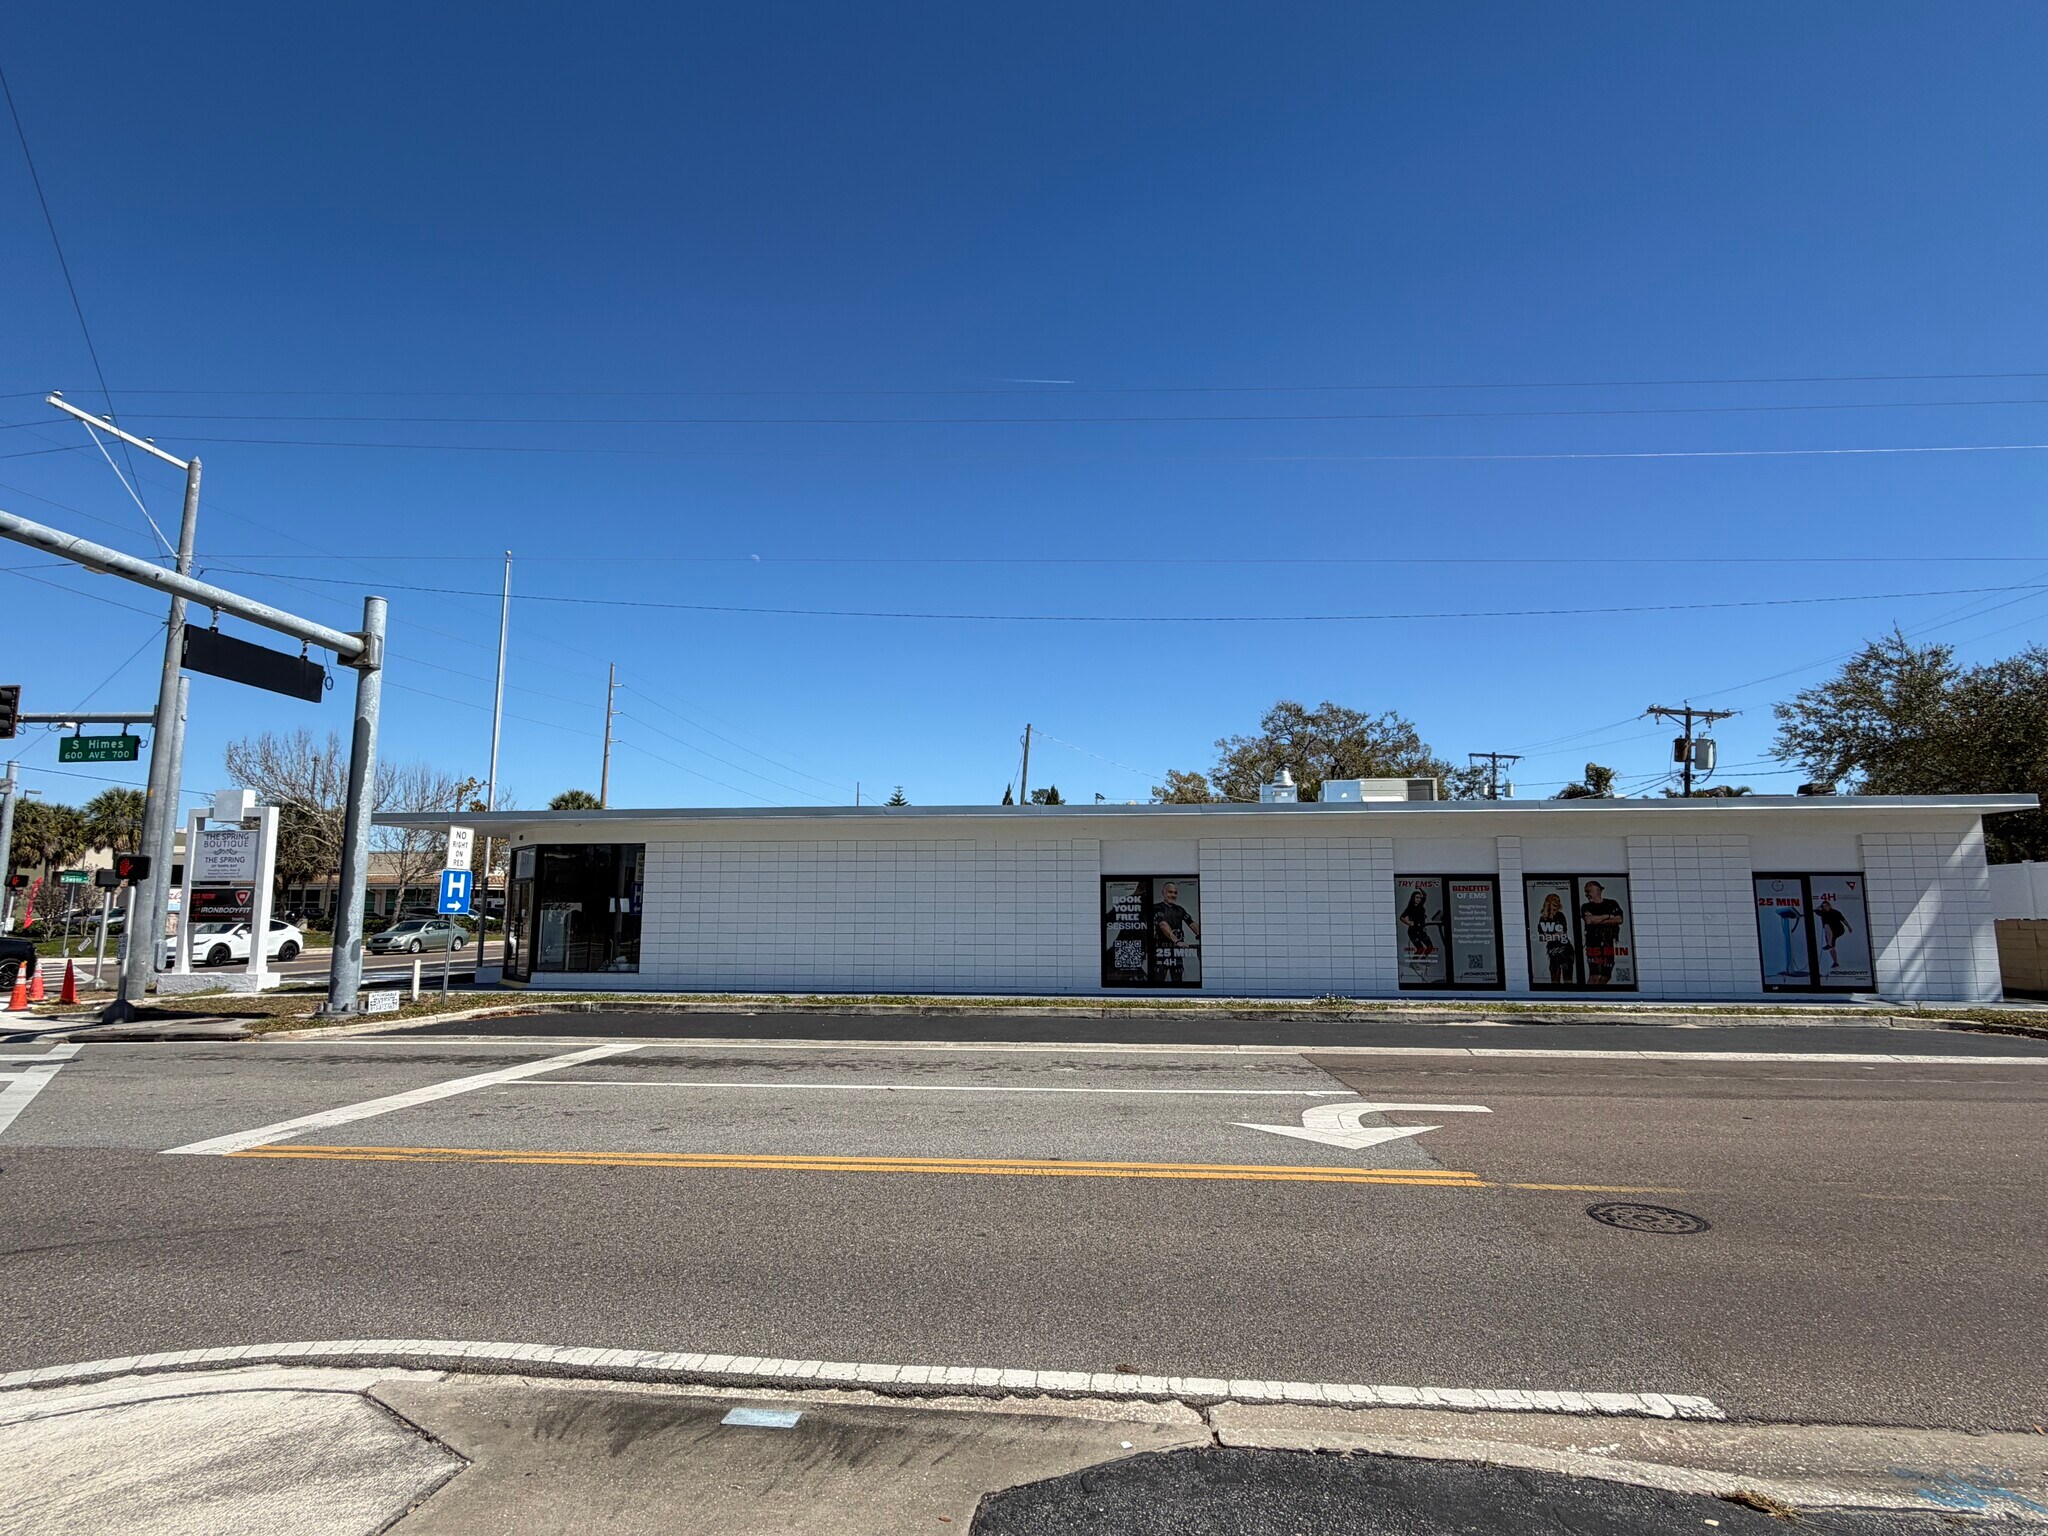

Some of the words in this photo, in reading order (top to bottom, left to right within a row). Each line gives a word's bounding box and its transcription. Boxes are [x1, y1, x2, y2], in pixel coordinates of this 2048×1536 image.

[72, 740, 80, 750] S
[88, 739, 124, 749] Himes
[65, 751, 83, 760] 600
[88, 751, 106, 759] AVE
[112, 750, 130, 758] 700
[221, 832, 250, 840] SPRING
[456, 831, 467, 840] NO
[203, 840, 249, 848] BOUTIQUE
[453, 841, 469, 849] RIGHT
[219, 856, 246, 864] SPRING
[453, 859, 464, 867] RED
[447, 872, 466, 898] H
[1398, 880, 1413, 888] TRY
[1415, 881, 1433, 889] EMS
[1112, 895, 1142, 904] BOOK
[1456, 892, 1467, 900] OF
[1820, 893, 1836, 901] 4H
[1758, 897, 1774, 907] 25
[1776, 898, 1800, 907] MIN
[1113, 904, 1142, 912] YOUR
[1115, 913, 1140, 921] FREE
[1106, 922, 1148, 930] SESSION
[1540, 921, 1564, 933] We
[1156, 948, 1172, 957] 25
[1173, 948, 1198, 957] MIN
[1603, 946, 1629, 956] MIN
